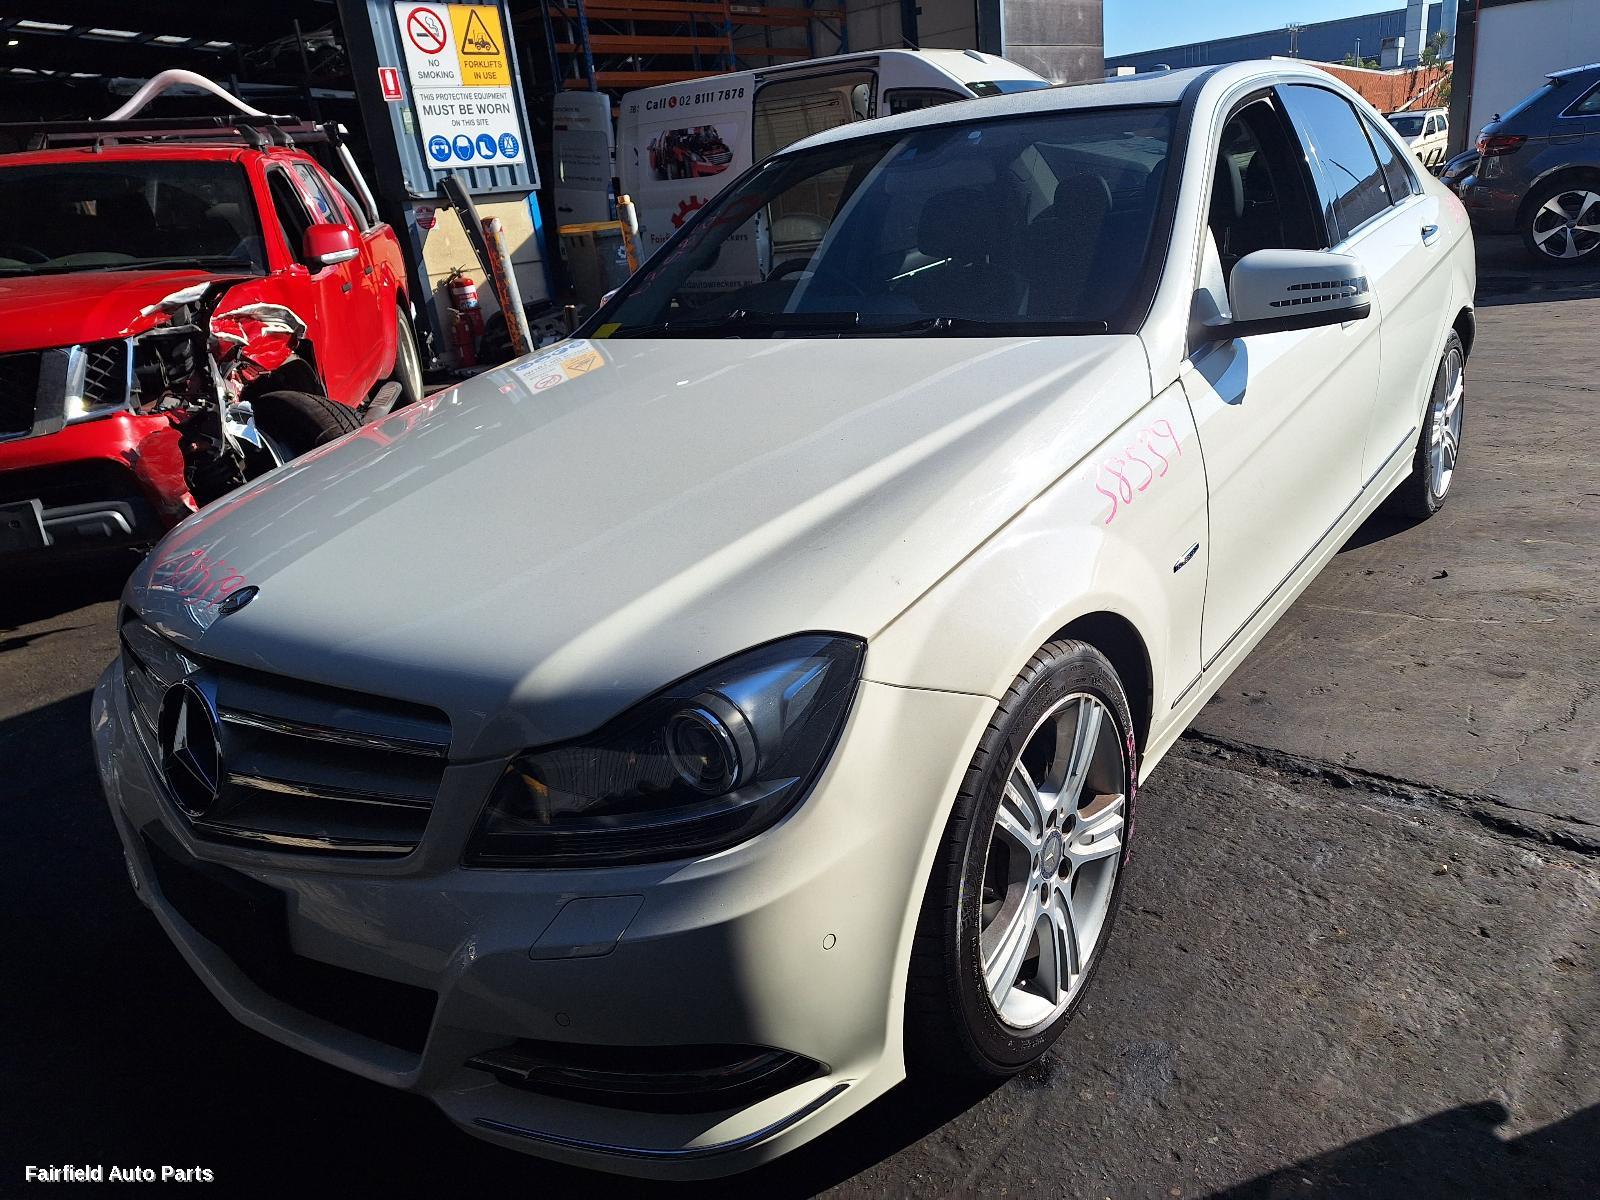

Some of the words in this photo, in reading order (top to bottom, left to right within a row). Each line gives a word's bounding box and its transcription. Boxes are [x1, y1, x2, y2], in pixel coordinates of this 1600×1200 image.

[428, 59, 440, 67] NO
[464, 60, 503, 68] FORKLIFTS
[417, 70, 455, 79] SMOKING
[473, 72, 482, 80] IN
[482, 71, 497, 80] USE
[419, 93, 435, 101] THIS
[435, 92, 473, 101] PROTECTIVE
[473, 92, 508, 100] EQUIPMENT
[646, 97, 666, 111] Call
[679, 95, 691, 106] 02
[694, 91, 715, 104] 8111
[718, 87, 745, 101] 7878
[422, 104, 455, 116] MUST
[458, 104, 475, 115] BE
[475, 103, 511, 114] WORN
[451, 119, 461, 127] ON
[461, 119, 476, 127] THIS
[476, 118, 490, 126] SITE
